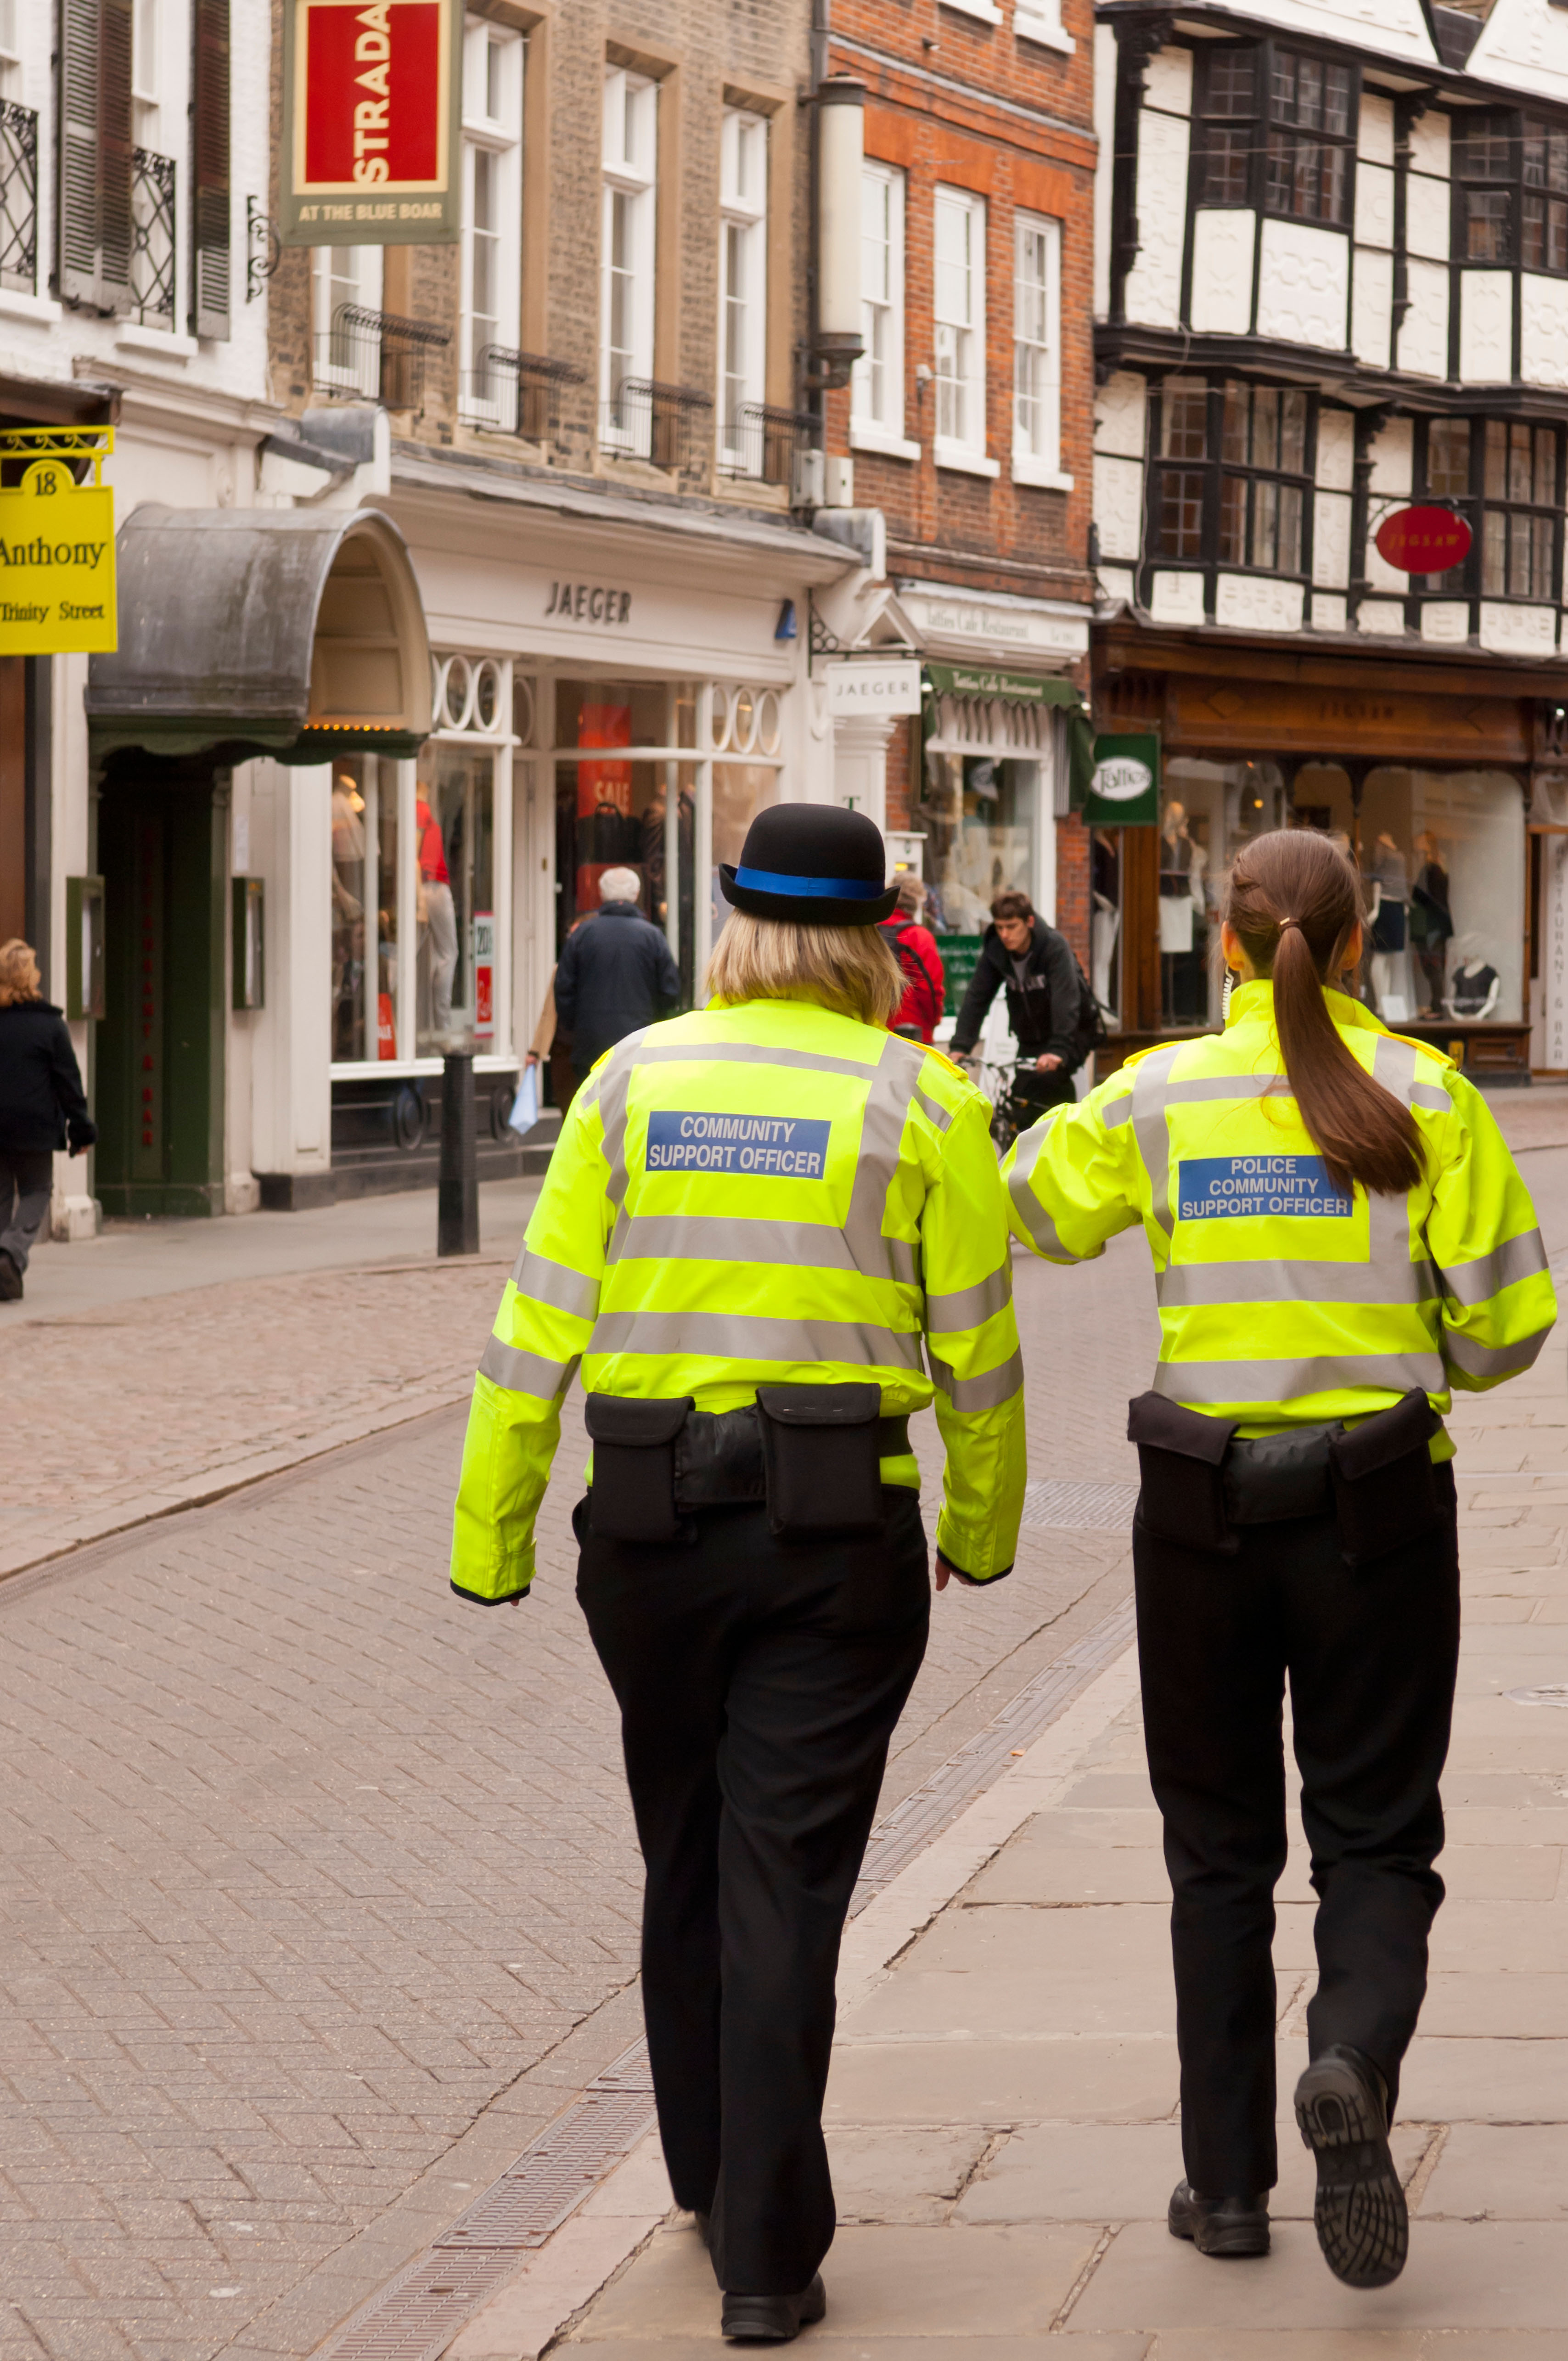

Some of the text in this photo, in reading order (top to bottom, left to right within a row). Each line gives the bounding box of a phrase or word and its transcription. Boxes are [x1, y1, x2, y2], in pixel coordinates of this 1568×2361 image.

[353, 4, 391, 182] STRADA
[299, 202, 442, 221] AT THE BLUE BOAR
[34, 472, 57, 496] 18
[0, 536, 107, 569] Anthony
[1388, 534, 1460, 549] JIGSAW
[0, 601, 104, 624] Trinity Street
[545, 581, 632, 624] JAEGER
[837, 682, 910, 697] JAEGER
[680, 1116, 796, 1143] COMMUNITY
[649, 1144, 821, 1174] SUPPORT OFFICER
[1231, 1158, 1297, 1175] POLICE
[1209, 1178, 1319, 1196] COMMUNITY
[1182, 1197, 1348, 1218] SUPPORT OFFICER
